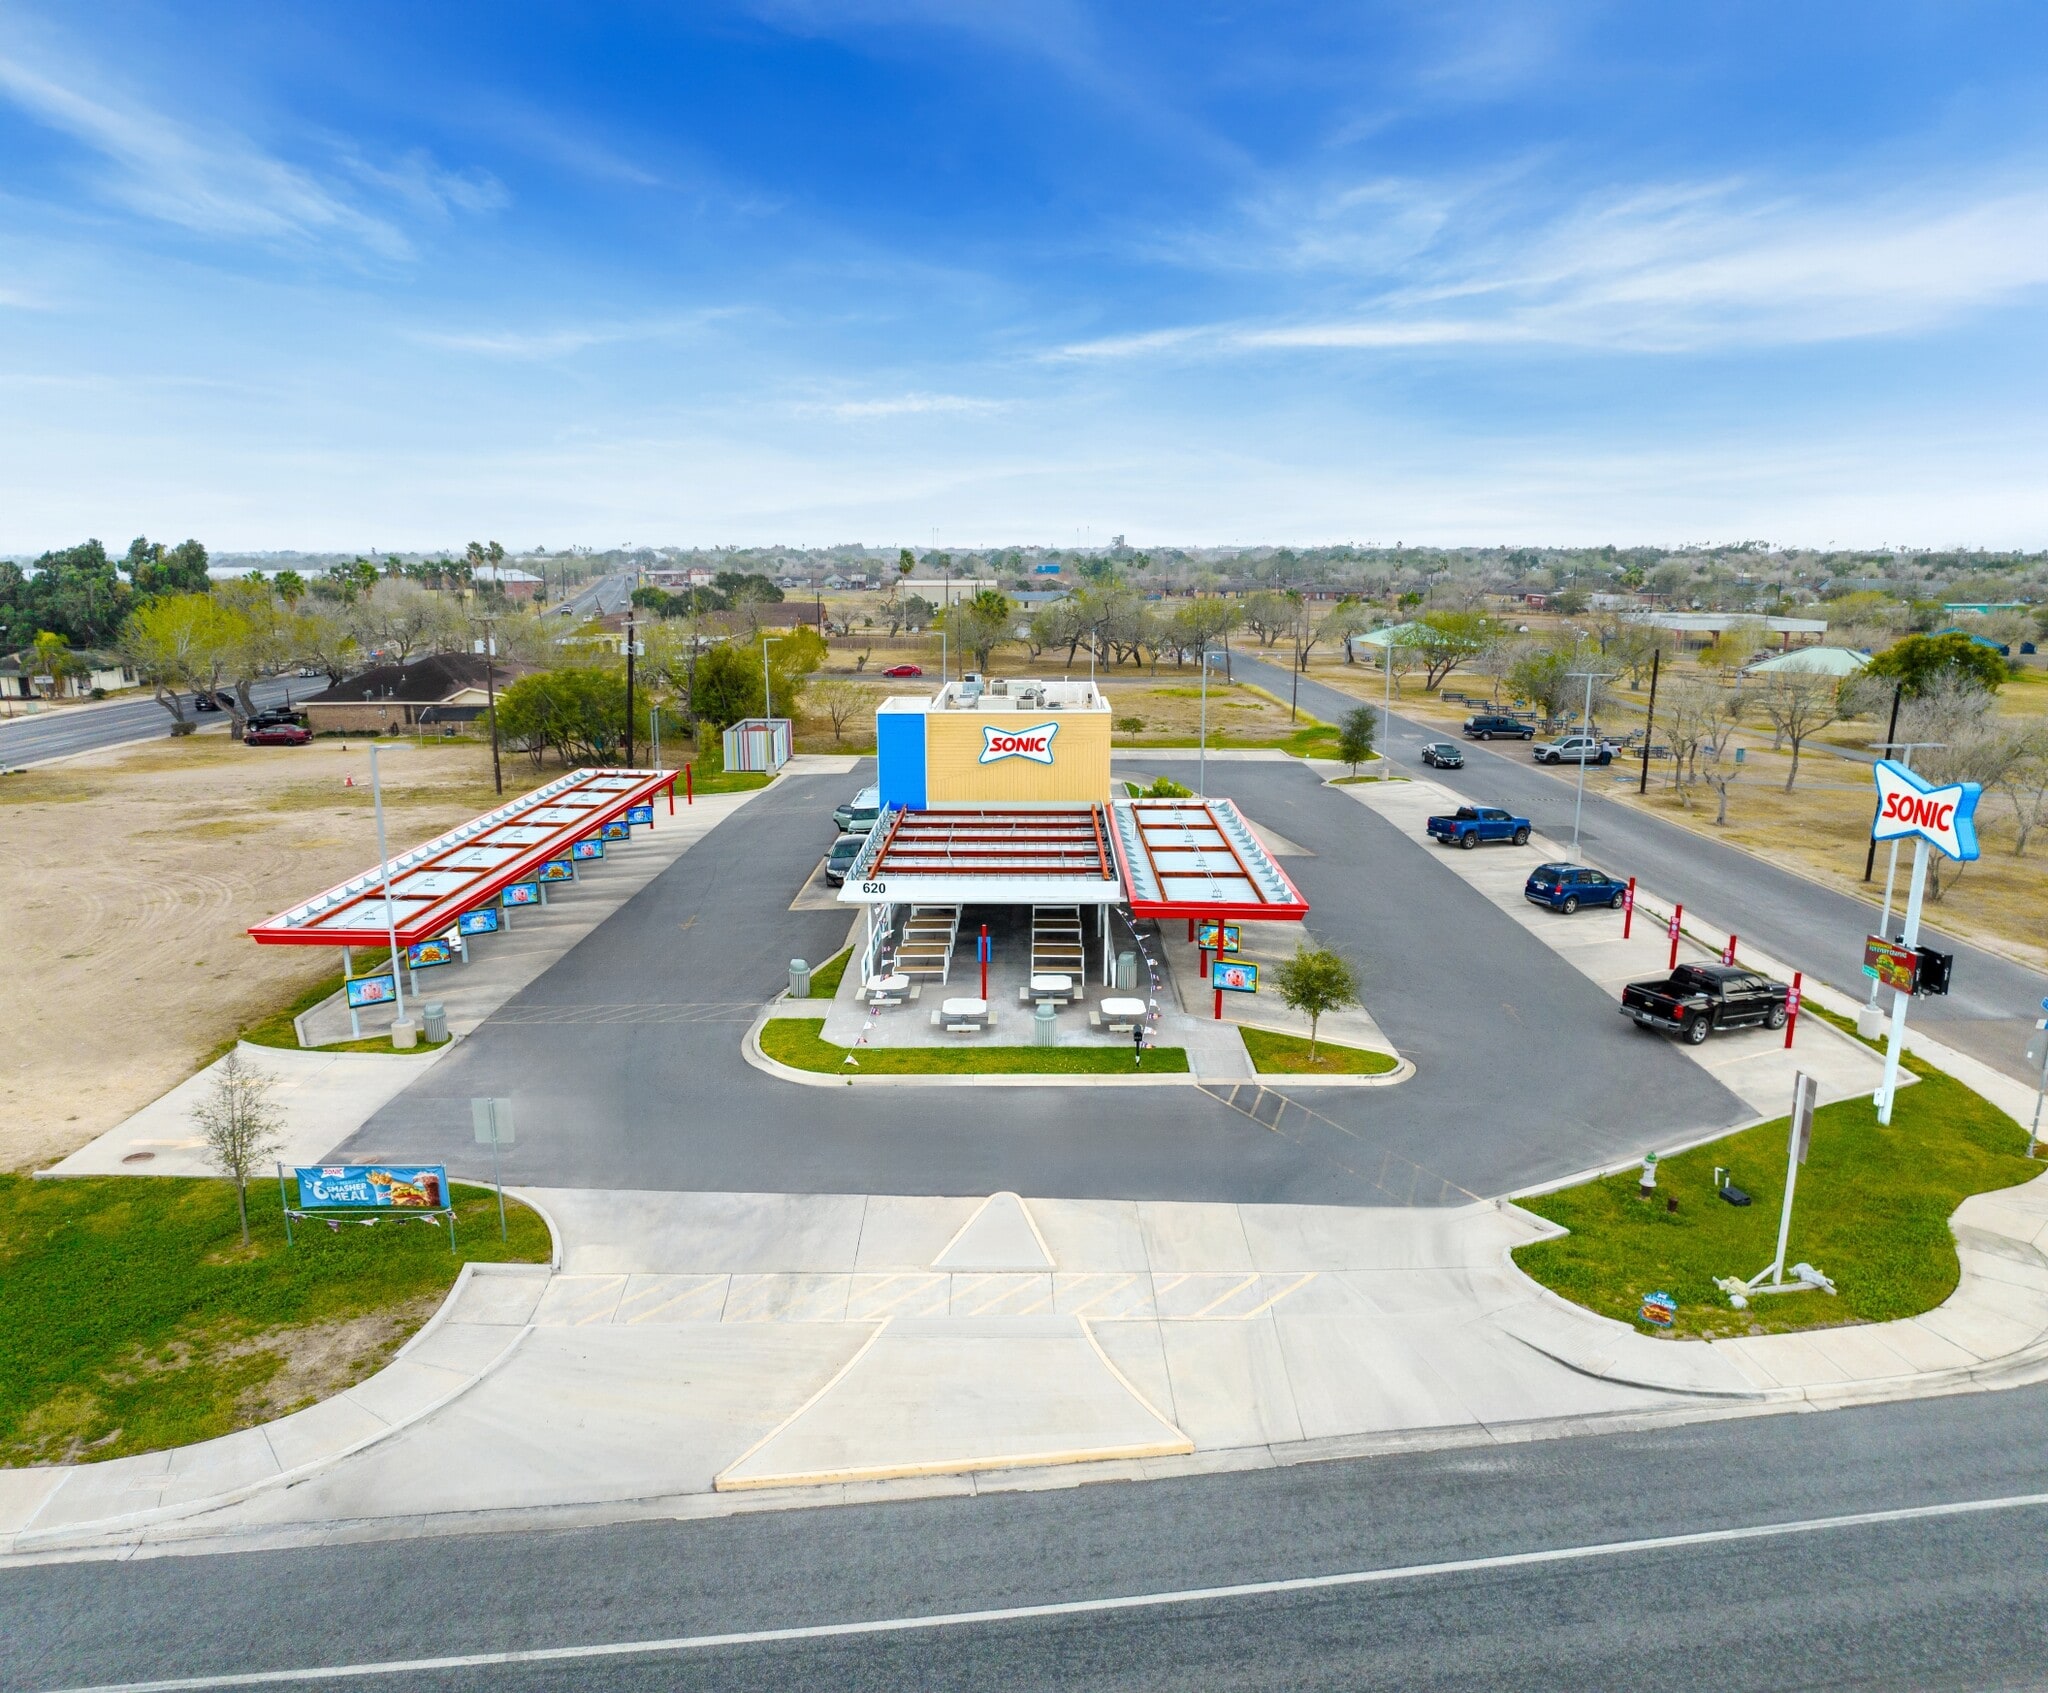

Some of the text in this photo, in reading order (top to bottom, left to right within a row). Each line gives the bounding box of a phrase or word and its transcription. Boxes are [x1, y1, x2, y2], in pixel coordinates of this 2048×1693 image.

[989, 737, 1047, 753] SONIC
[1882, 792, 1954, 832] SONIC
[862, 882, 887, 895] 620
[304, 1180, 330, 1200] $6
[326, 1182, 367, 1193] SMASHER
[330, 1189, 369, 1201] MEAL
